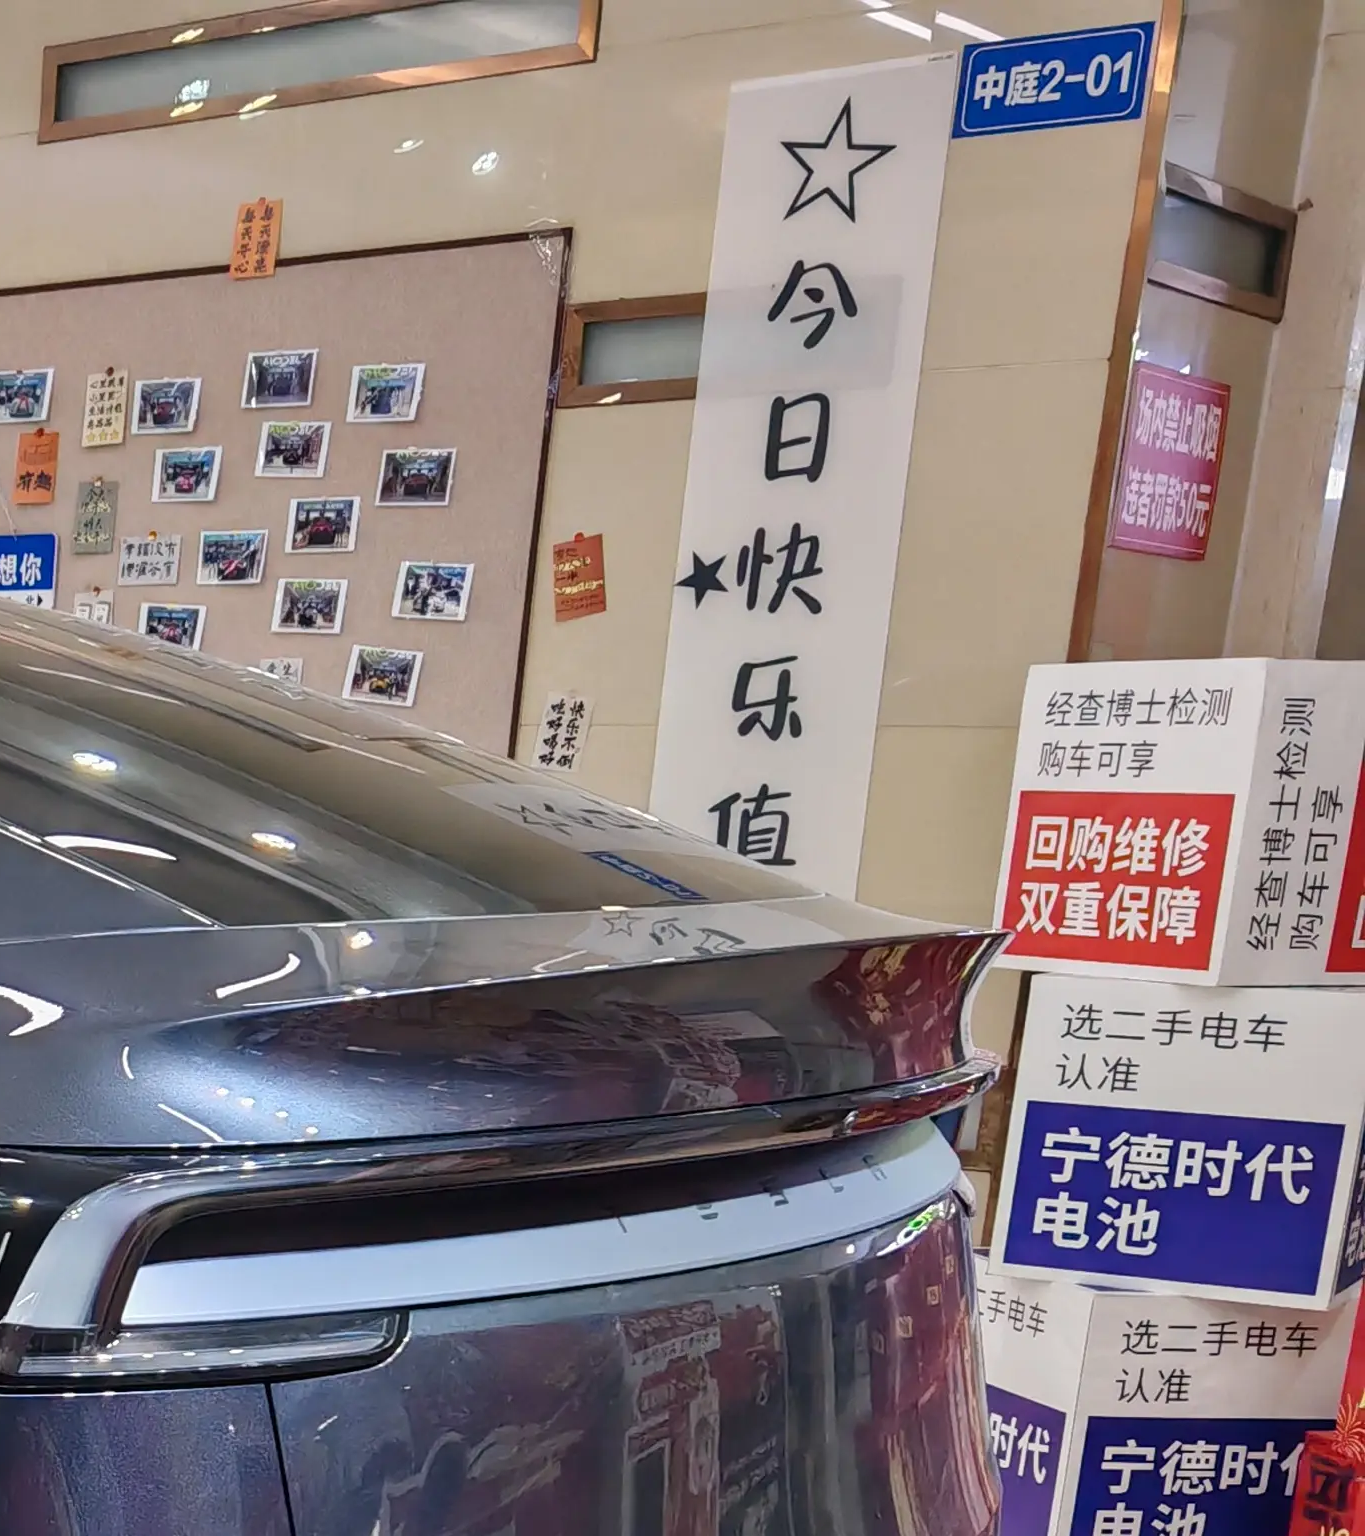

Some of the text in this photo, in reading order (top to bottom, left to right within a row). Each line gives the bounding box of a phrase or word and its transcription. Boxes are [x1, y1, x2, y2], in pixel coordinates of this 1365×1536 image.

[974, 50, 1134, 110] 中庭2-01
[1136, 386, 1222, 463] 场内禁止吸烟
[1122, 465, 1212, 538] 违者罚款50元
[708, 259, 857, 866] 今日快乐值
[1045, 687, 1233, 728] 经查博士检测
[1037, 740, 1158, 778] 购车可享
[1025, 815, 1211, 877] 回购维修
[1246, 697, 1316, 951] 经查博士检测
[1289, 785, 1344, 951] 购车可享
[1016, 881, 1200, 945] 双重保障
[1061, 1003, 1288, 1053] 选二手电车
[1055, 1053, 1140, 1093] 认准
[1041, 1127, 1314, 1205] 宁德时代
[1032, 1191, 1161, 1257] 电池
[1121, 1319, 1318, 1358] 选二手电车
[1115, 1367, 1191, 1404] 认准
